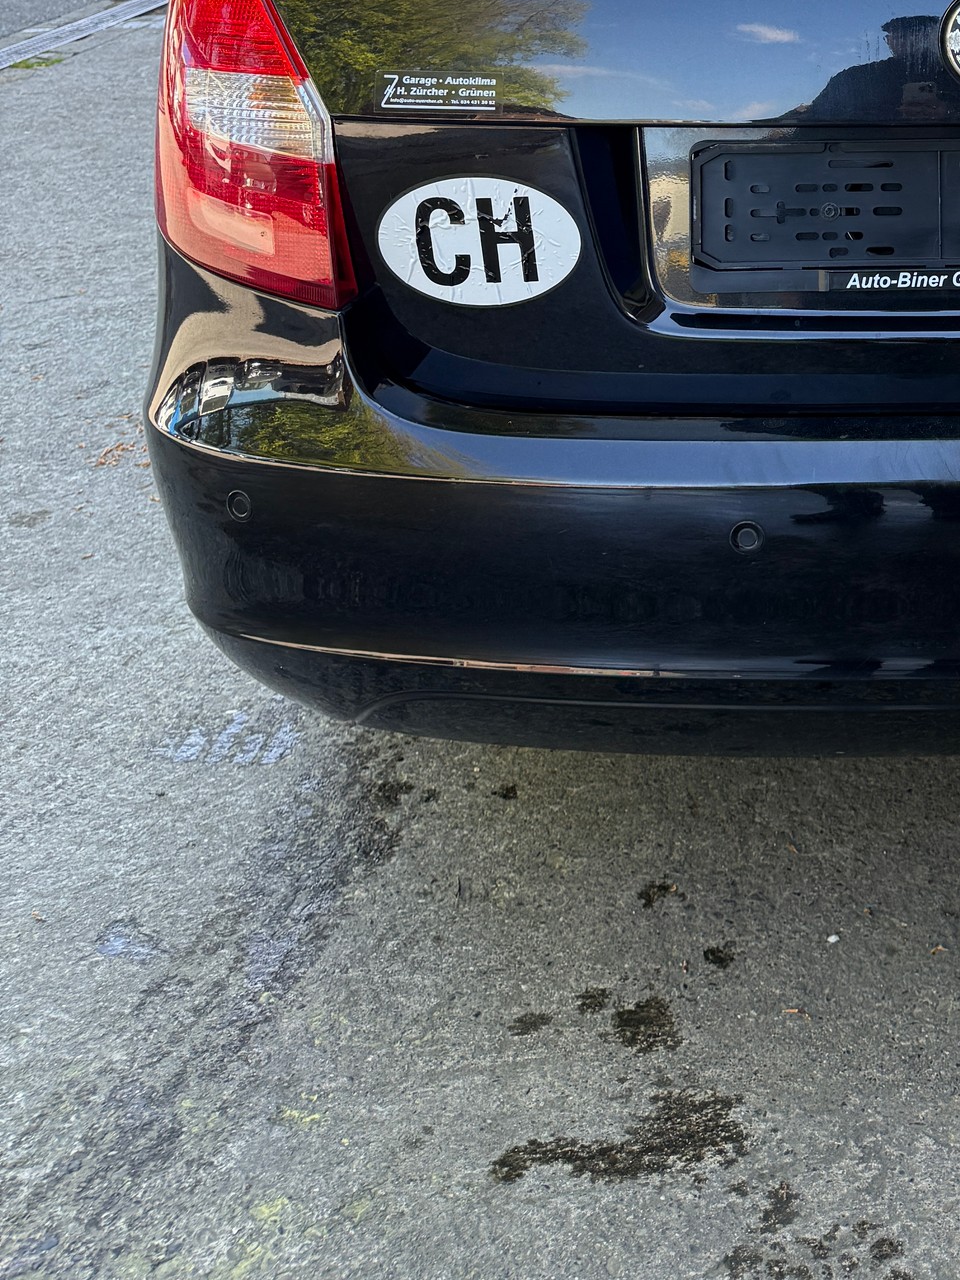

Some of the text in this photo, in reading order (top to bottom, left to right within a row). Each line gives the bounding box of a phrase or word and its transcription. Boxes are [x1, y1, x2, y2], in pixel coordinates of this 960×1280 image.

[402, 75, 497, 86] Garage Autoklima
[396, 86, 496, 97] H. Zürcher Grünen
[415, 196, 539, 287] CH
[846, 272, 948, 289] Auto-Biner
